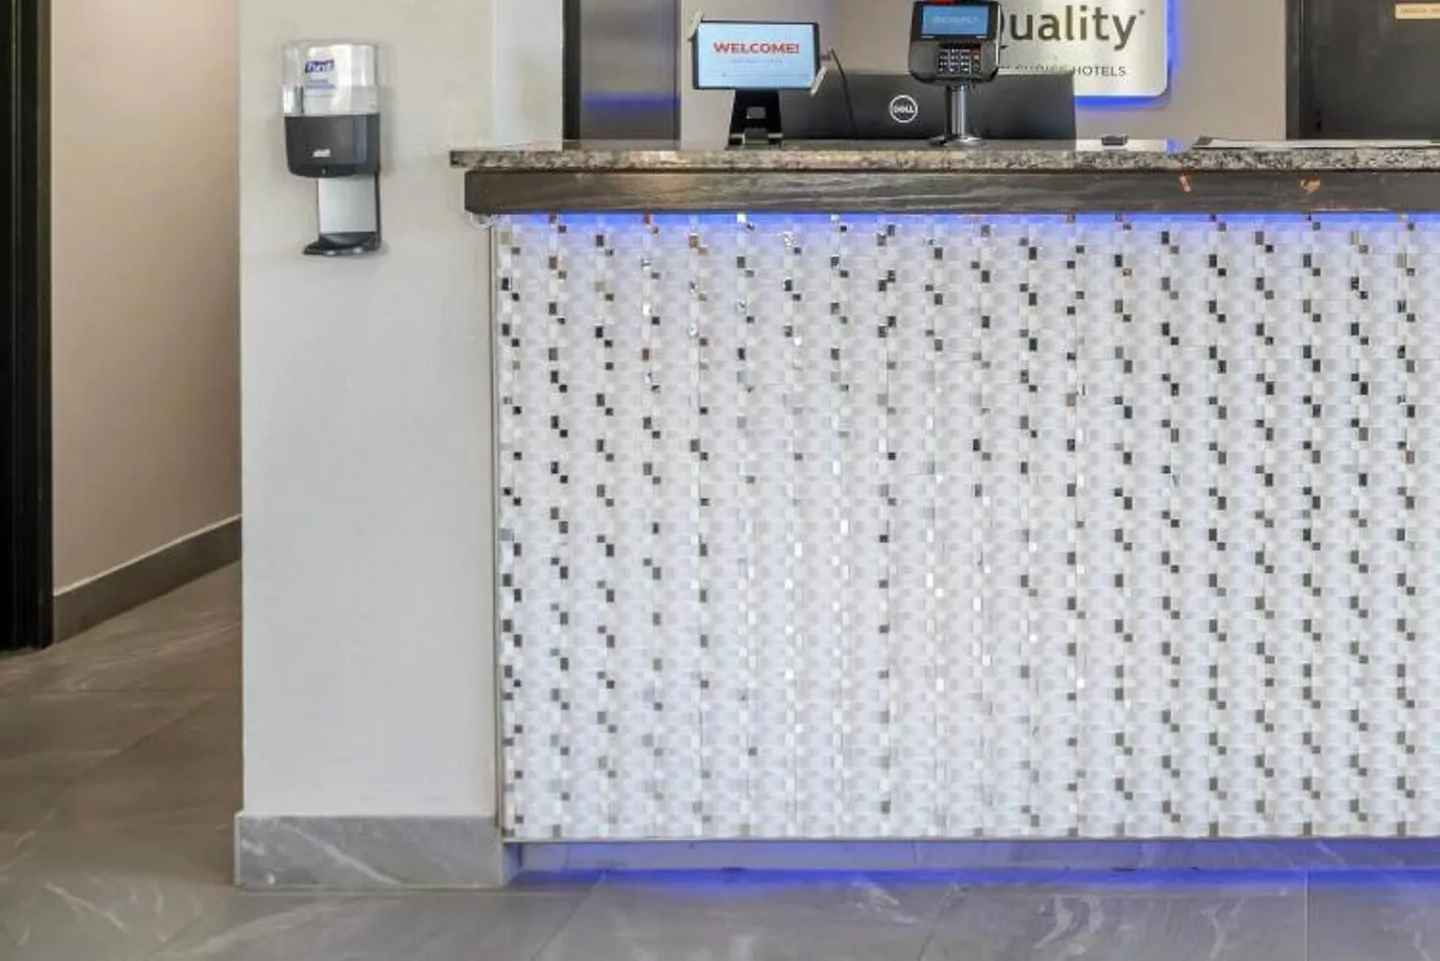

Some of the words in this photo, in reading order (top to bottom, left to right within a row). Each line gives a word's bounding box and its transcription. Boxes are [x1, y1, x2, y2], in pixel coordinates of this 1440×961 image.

[1001, 5, 1138, 51] uality
[713, 41, 800, 55] WELCOME!
[1073, 65, 1127, 77] HOTELS
